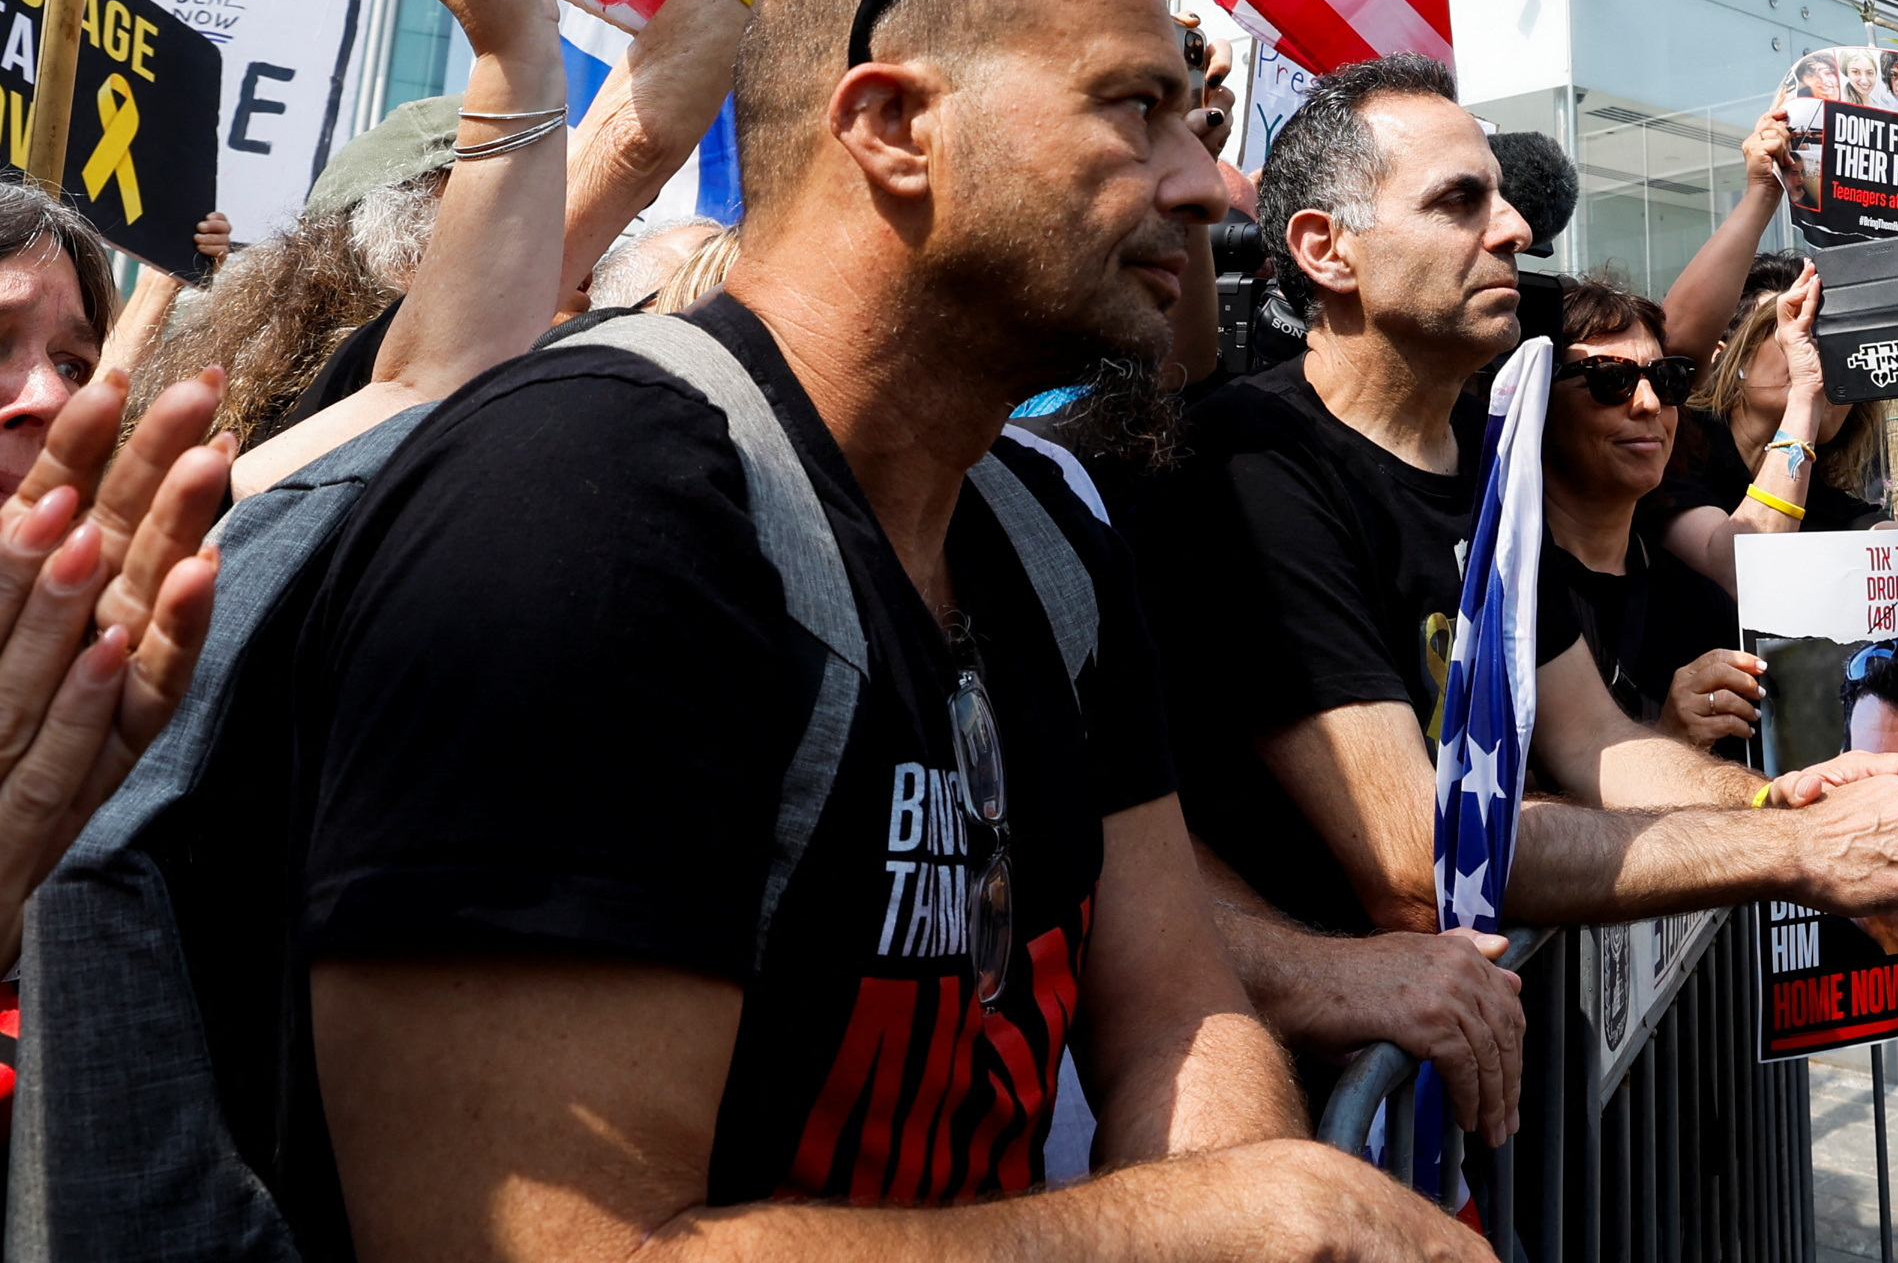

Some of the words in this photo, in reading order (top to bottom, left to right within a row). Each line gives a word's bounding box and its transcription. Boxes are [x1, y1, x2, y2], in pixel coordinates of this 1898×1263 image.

[172, 8, 240, 29] NOW
[1834, 112, 1886, 150] DON'T
[1834, 143, 1888, 184] THEIR
[1832, 181, 1887, 208] Teenagers
[1865, 546, 1892, 571] אור
[1771, 921, 1820, 974] HIM
[1773, 973, 1845, 1031] HOME
